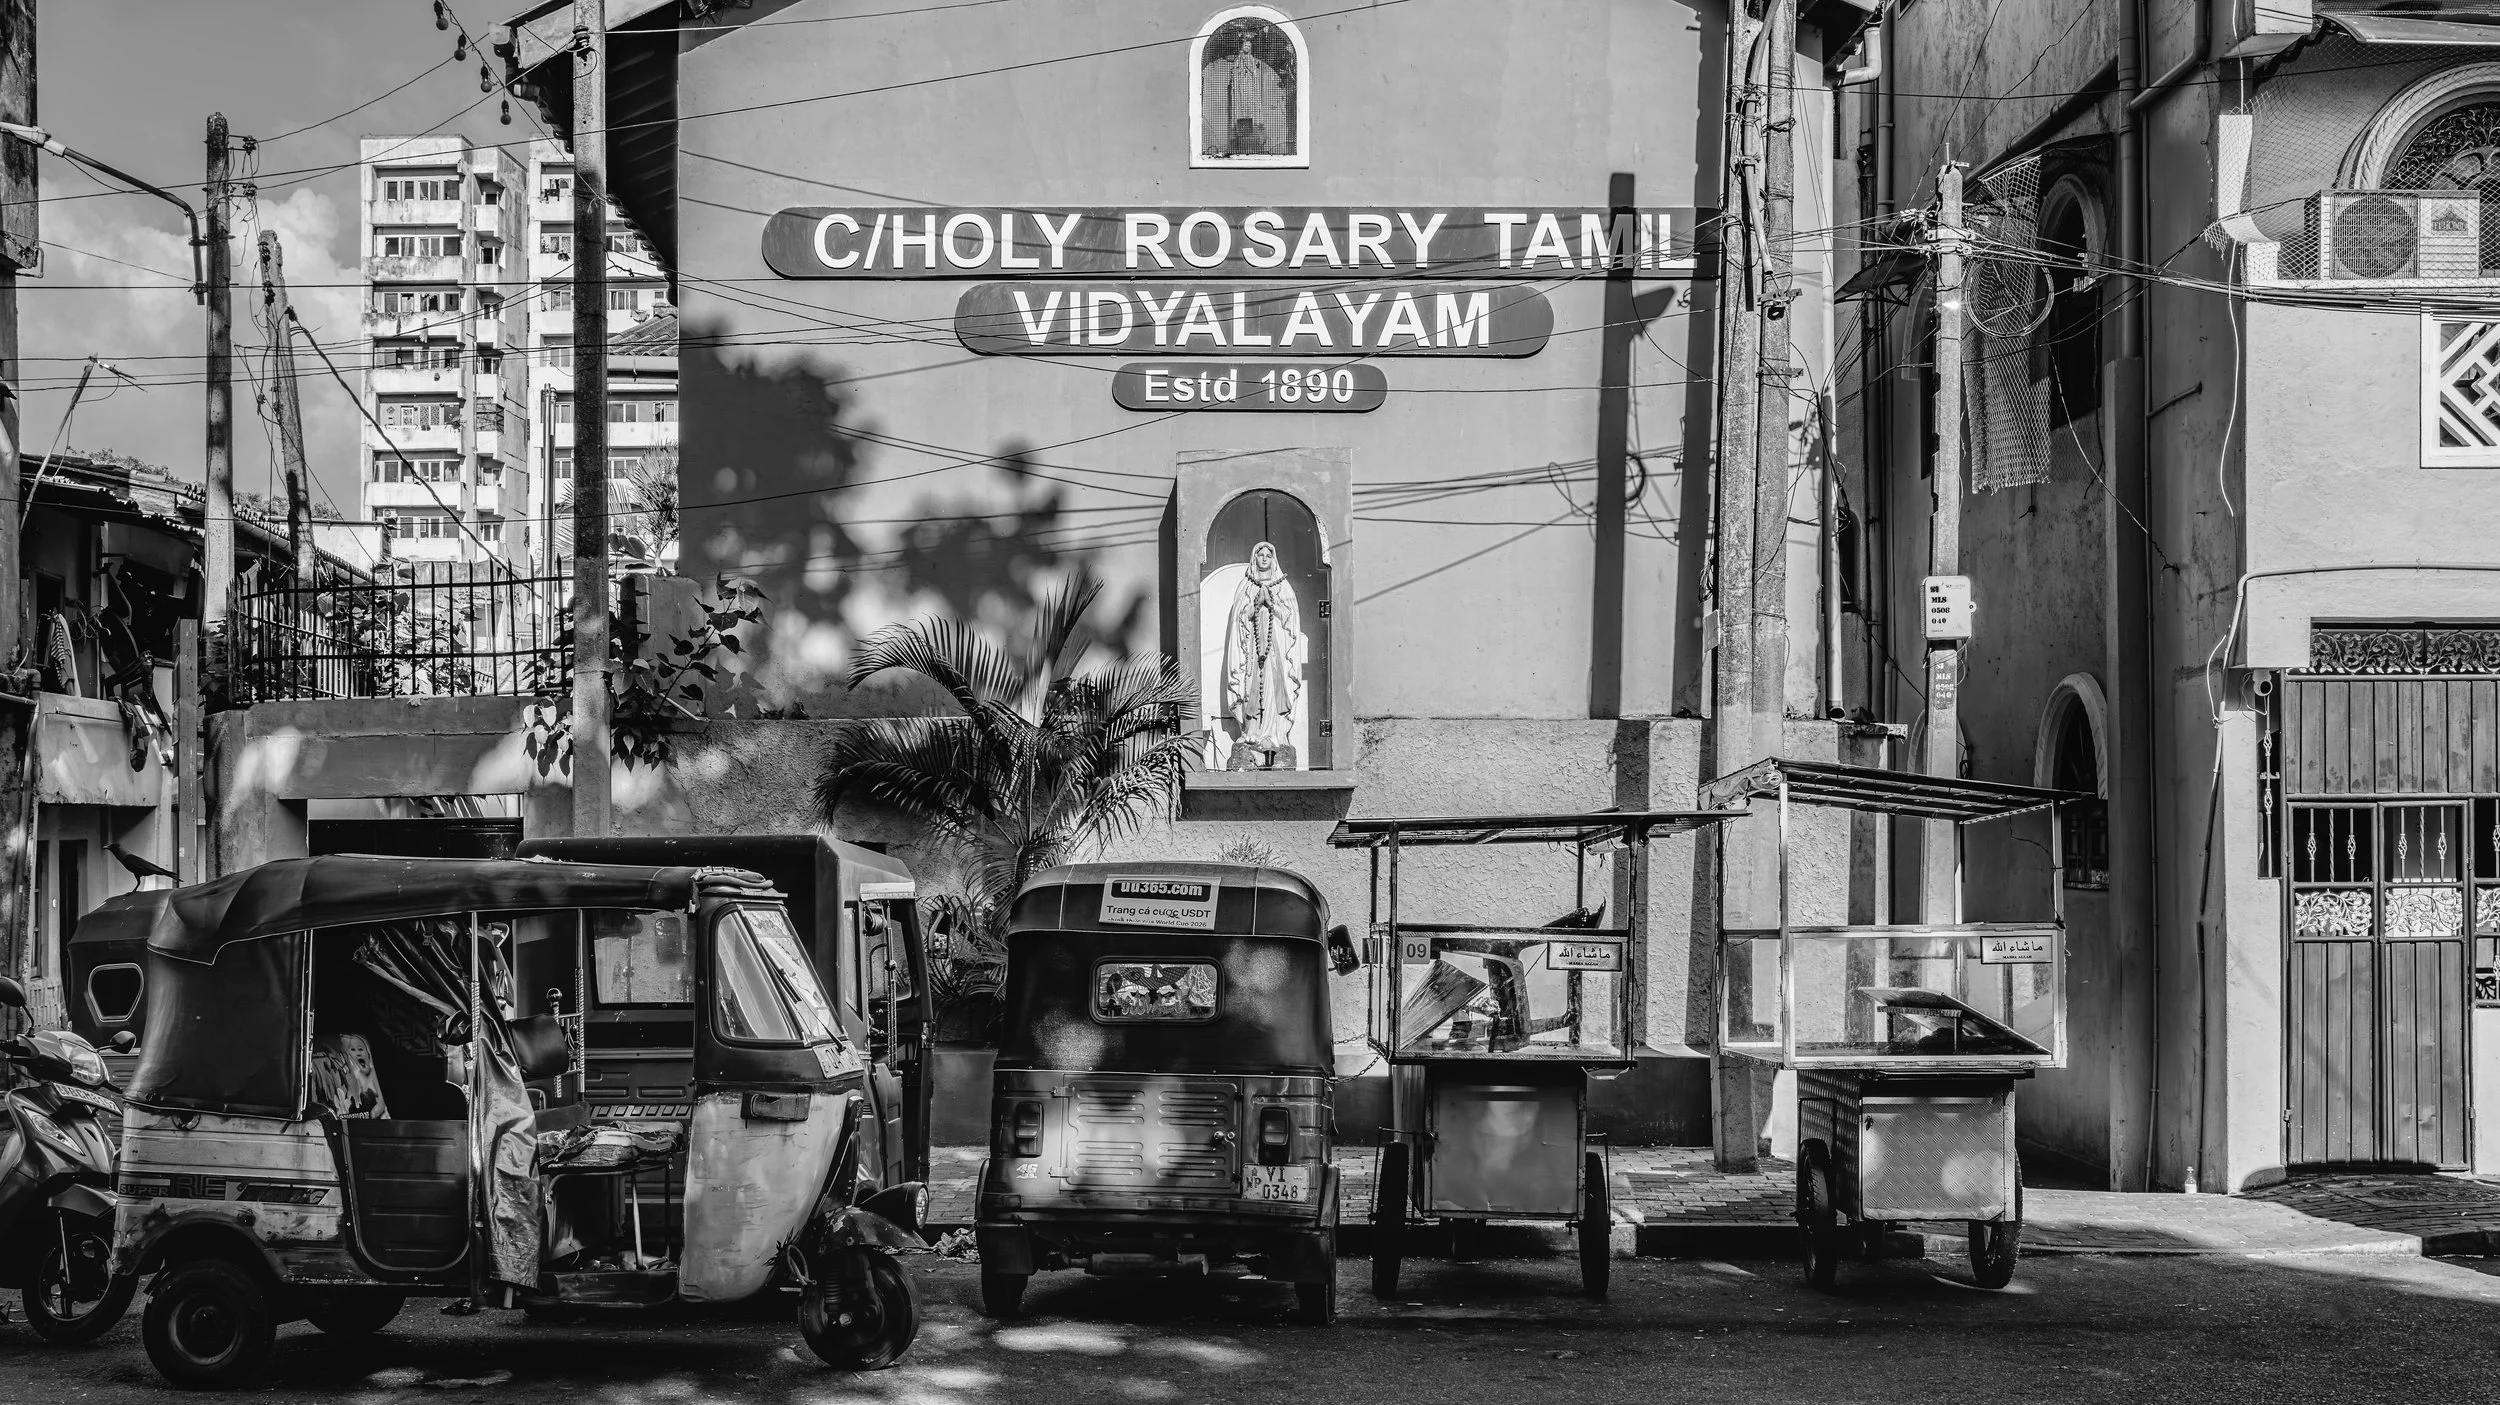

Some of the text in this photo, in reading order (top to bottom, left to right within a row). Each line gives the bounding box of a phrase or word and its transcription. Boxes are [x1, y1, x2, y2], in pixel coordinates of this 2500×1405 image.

[813, 211, 1698, 270] C/HOLY ROSARY TAMIL
[1012, 290, 1491, 348] VIDYALAYAM
[1144, 369, 1354, 403] Estd 1890
[1106, 905, 1136, 917] Trang
[1138, 906, 1150, 915] cá
[1181, 908, 1211, 918] USDT
[1406, 943, 1427, 959] 09
[119, 1183, 170, 1197] SUPER
[1263, 1183, 1299, 1200] 0348
